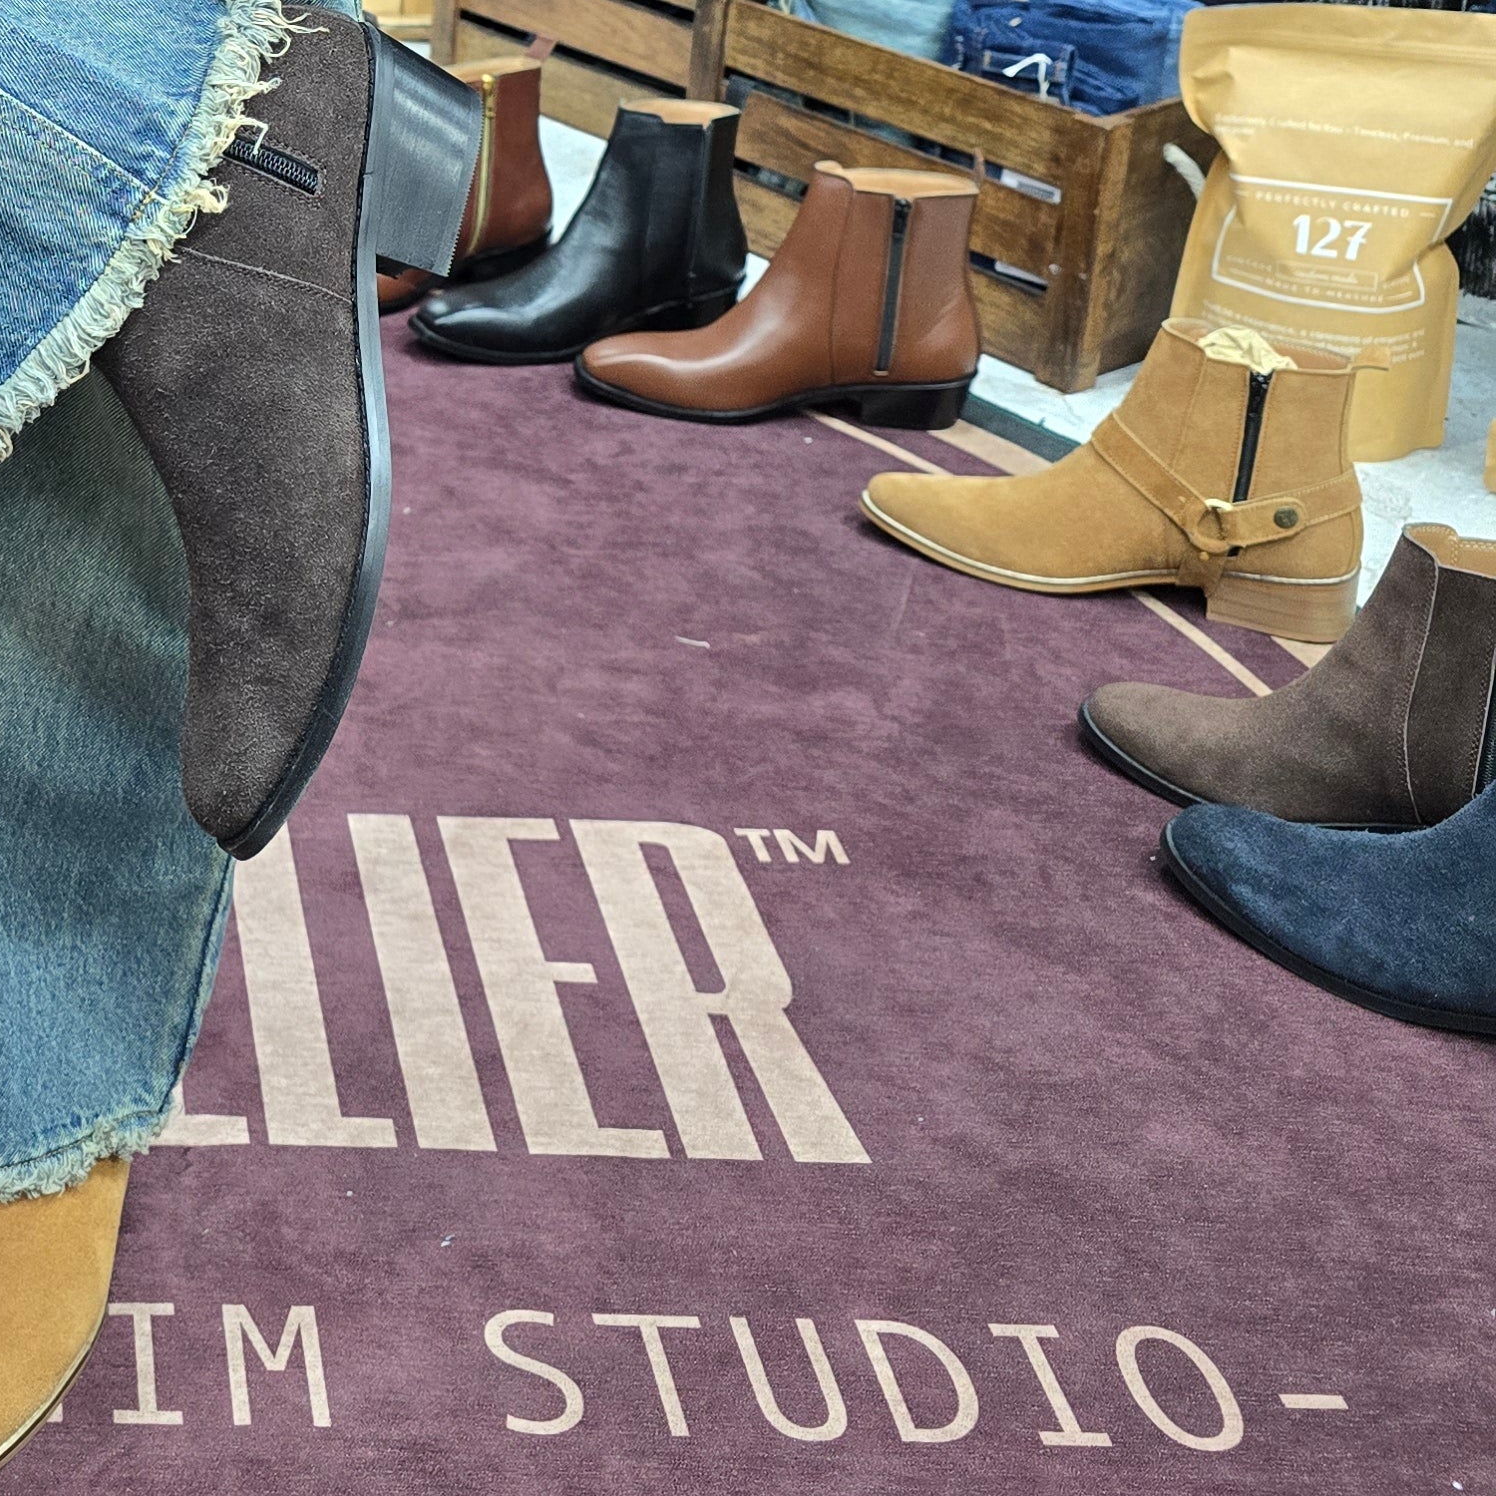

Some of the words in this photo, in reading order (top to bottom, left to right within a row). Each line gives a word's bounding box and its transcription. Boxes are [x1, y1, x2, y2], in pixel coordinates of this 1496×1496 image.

[1254, 190, 1337, 211] PERFECTLY
[1341, 201, 1410, 219] CRAFTED
[1291, 213, 1373, 262] 127
